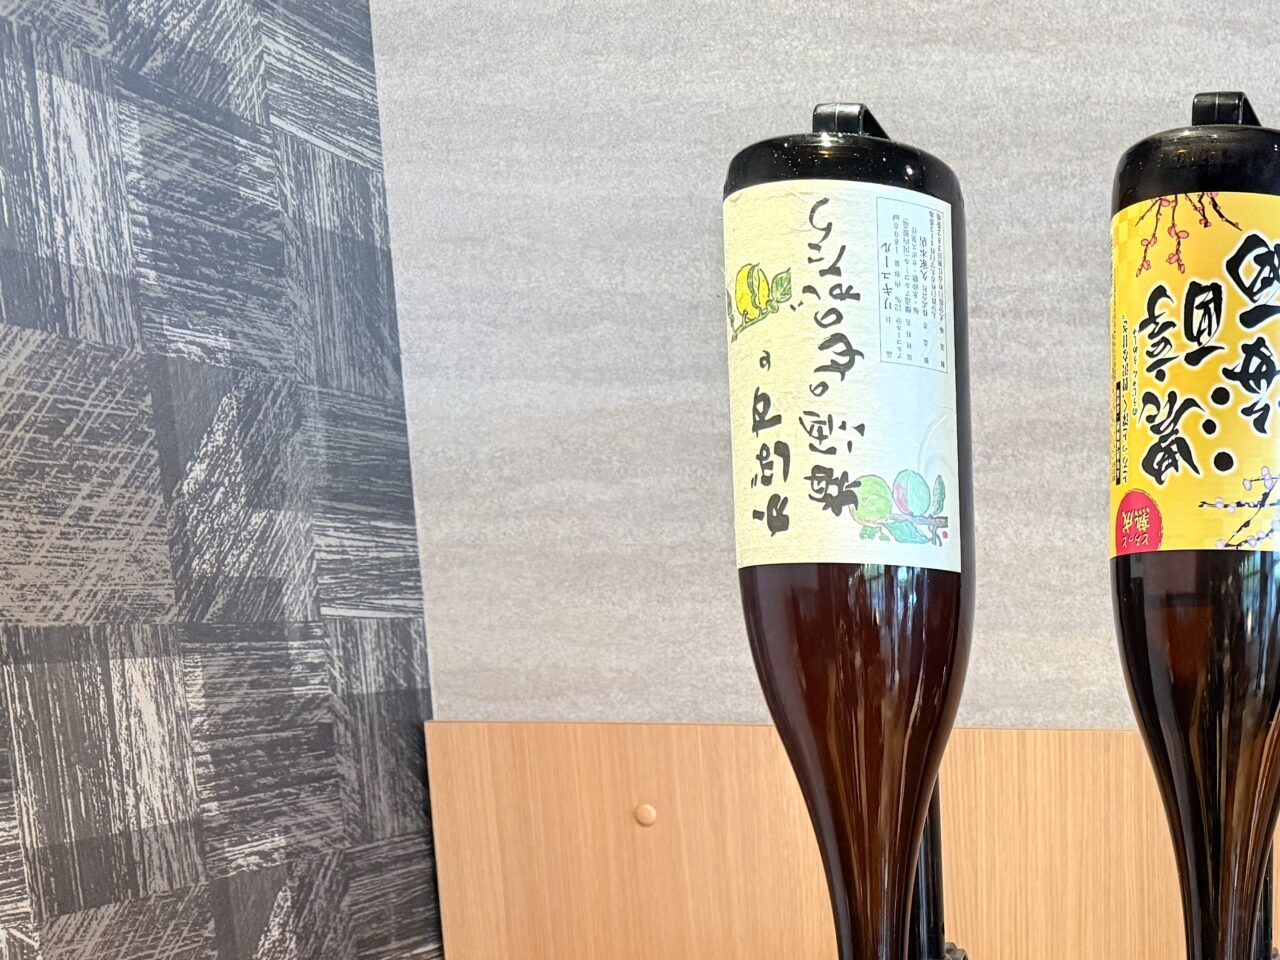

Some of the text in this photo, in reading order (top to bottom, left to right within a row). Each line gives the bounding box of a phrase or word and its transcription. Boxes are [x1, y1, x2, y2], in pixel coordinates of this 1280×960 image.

[881, 242, 893, 310] リキュール
[790, 198, 865, 516] 梅酒のものがたり
[1136, 282, 1235, 486] 濃醇
[750, 350, 790, 537] かぼすと
[1120, 508, 1150, 532] 熟成
[1121, 533, 1150, 547] とろっと
